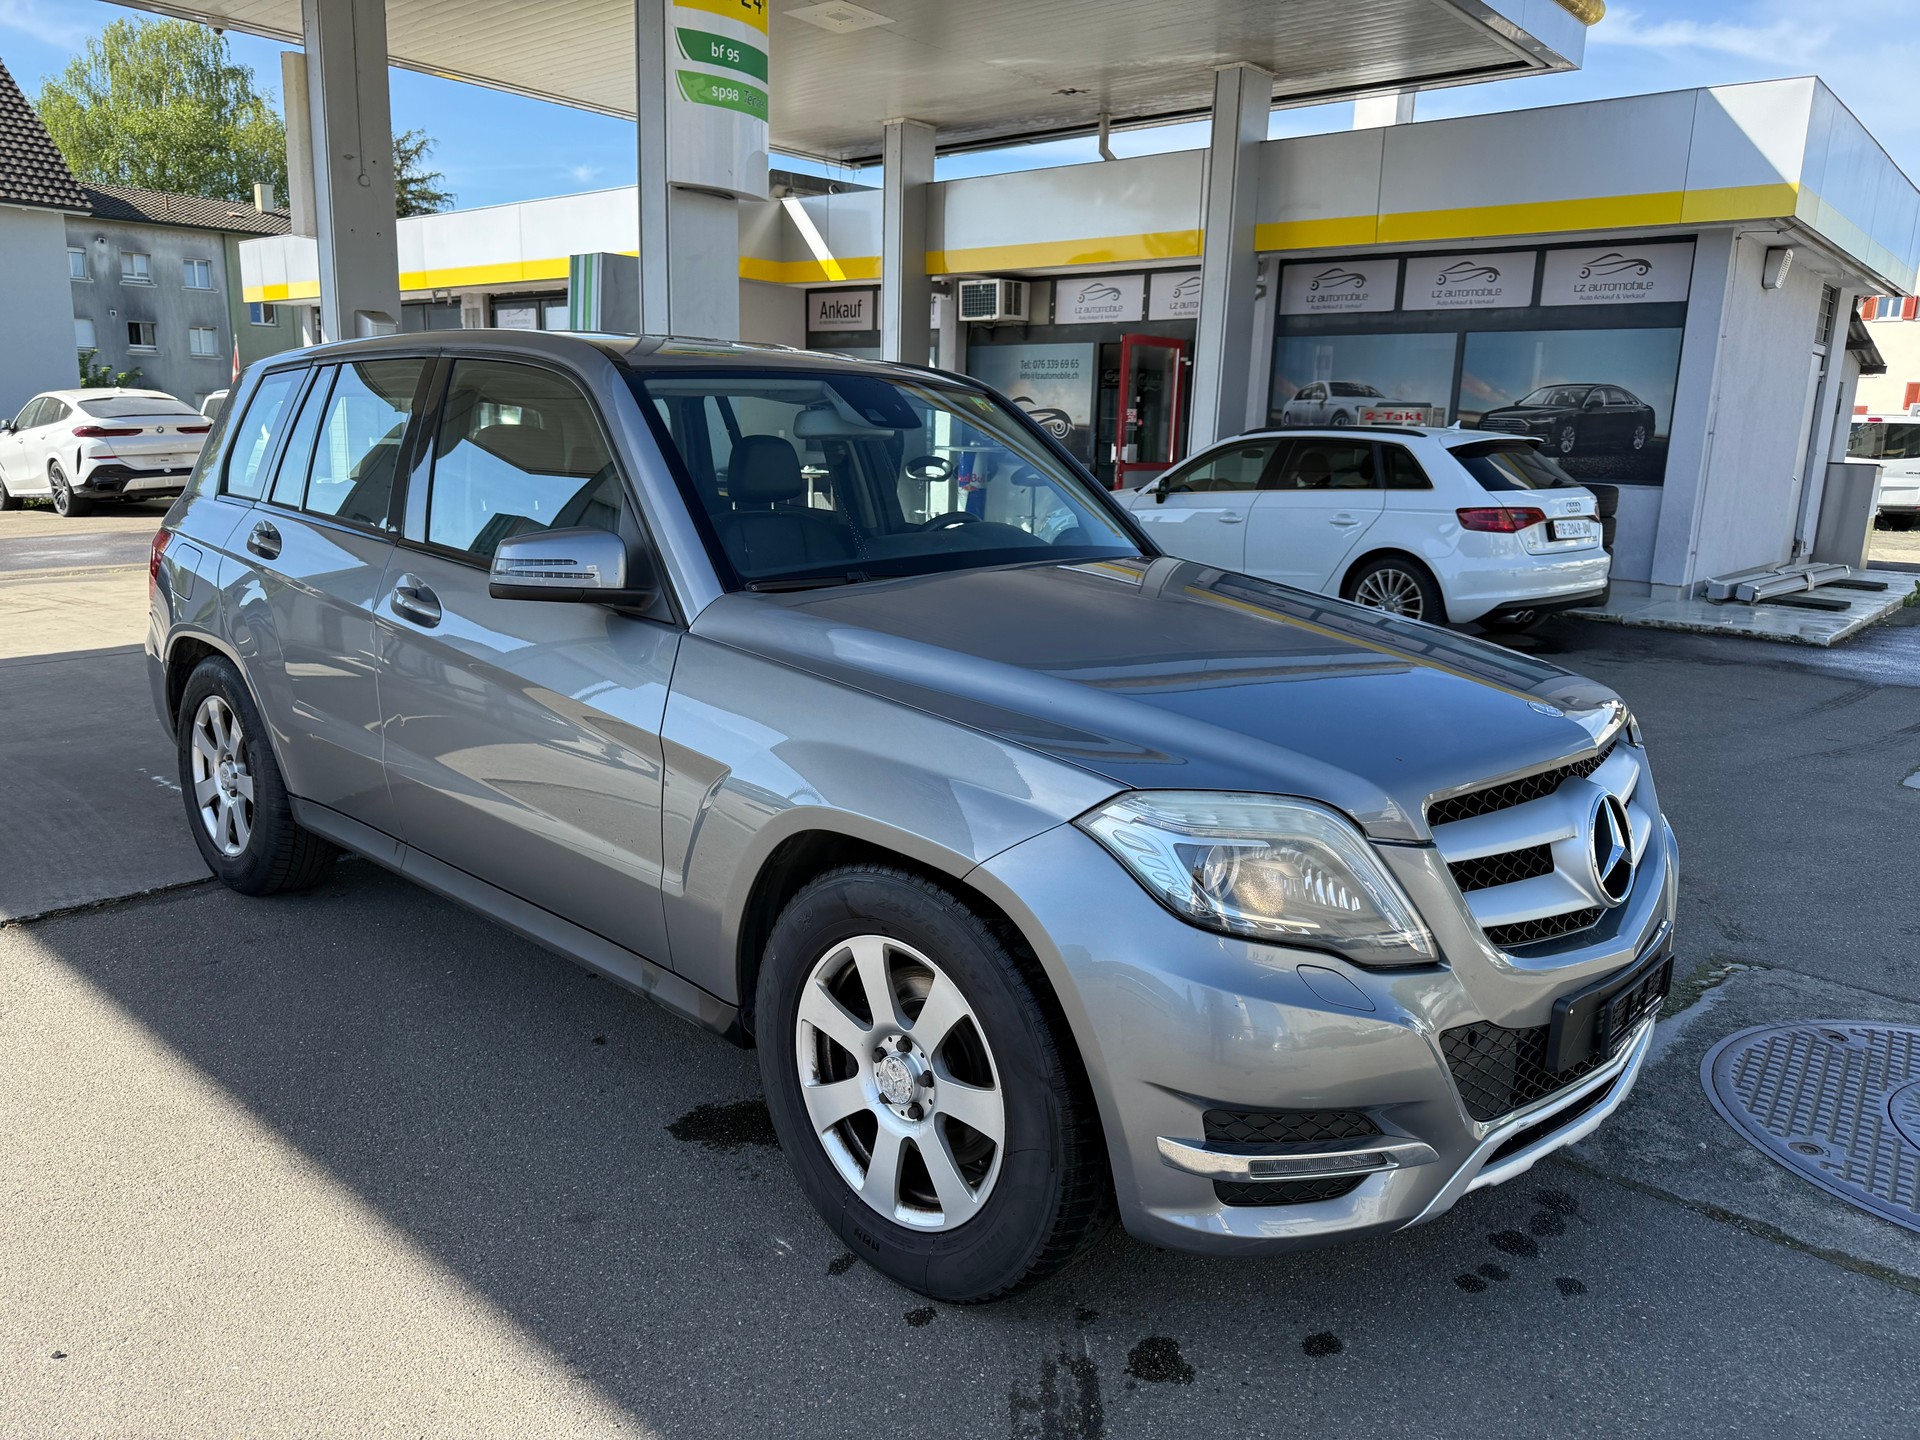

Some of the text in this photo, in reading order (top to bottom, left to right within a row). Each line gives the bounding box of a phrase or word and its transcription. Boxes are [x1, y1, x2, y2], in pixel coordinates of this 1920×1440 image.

[711, 42, 740, 63] bf 95
[711, 86, 739, 102] sp98
[1573, 284, 1586, 292] LZ
[1431, 290, 1442, 298] LZ
[820, 299, 862, 319] Ankauf
[1032, 360, 1046, 369] 076
[1046, 360, 1059, 369] 339
[1060, 359, 1070, 369] 69
[1070, 359, 1080, 369] 65
[1364, 411, 1424, 421] 2-Takt
